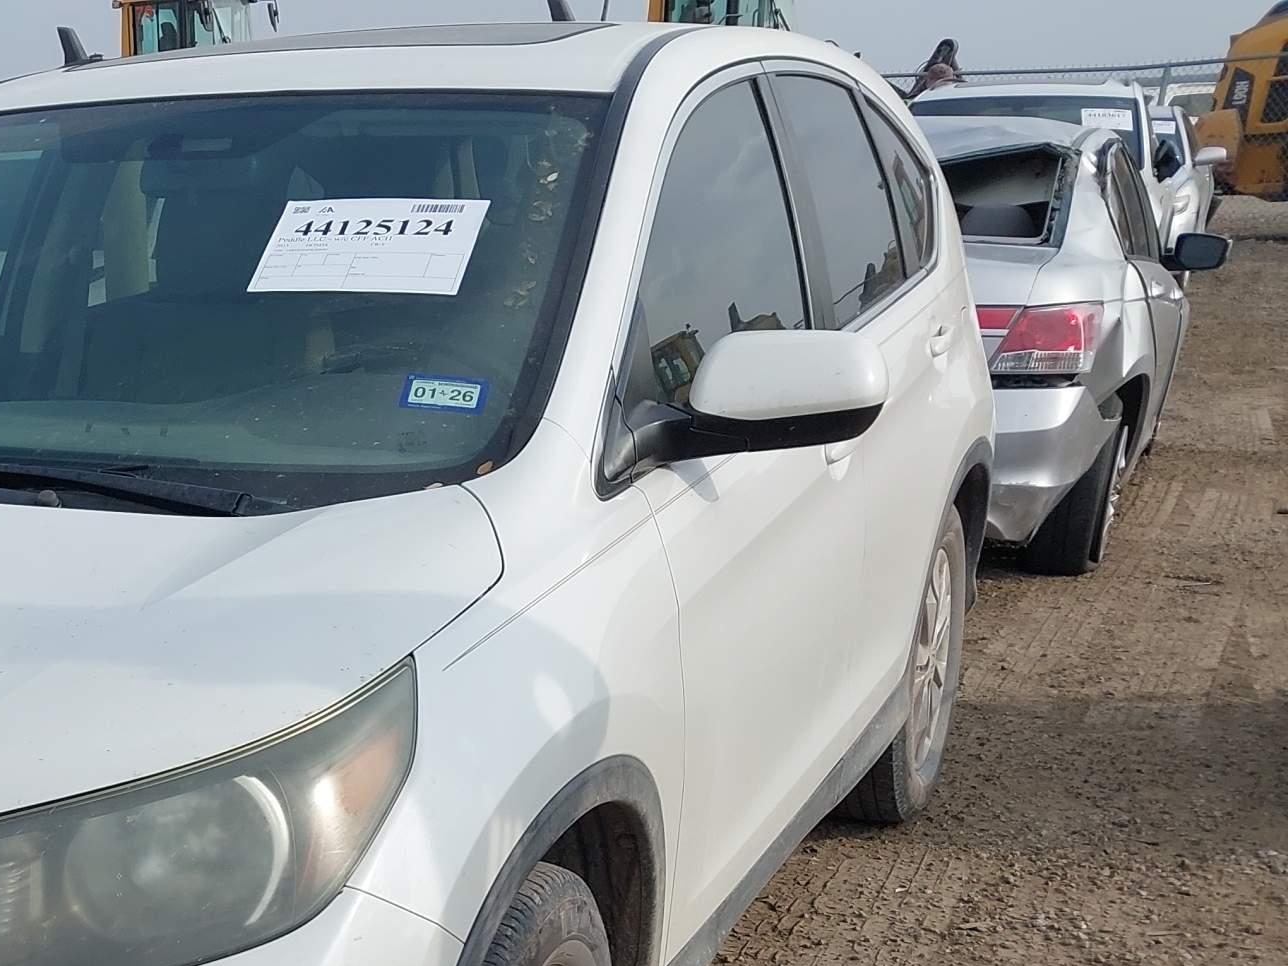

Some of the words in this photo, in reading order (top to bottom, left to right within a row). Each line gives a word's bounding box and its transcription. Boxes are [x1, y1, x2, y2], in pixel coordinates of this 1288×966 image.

[294, 219, 454, 236] 44125124
[414, 386, 437, 399] 01
[449, 389, 475, 402] 26
